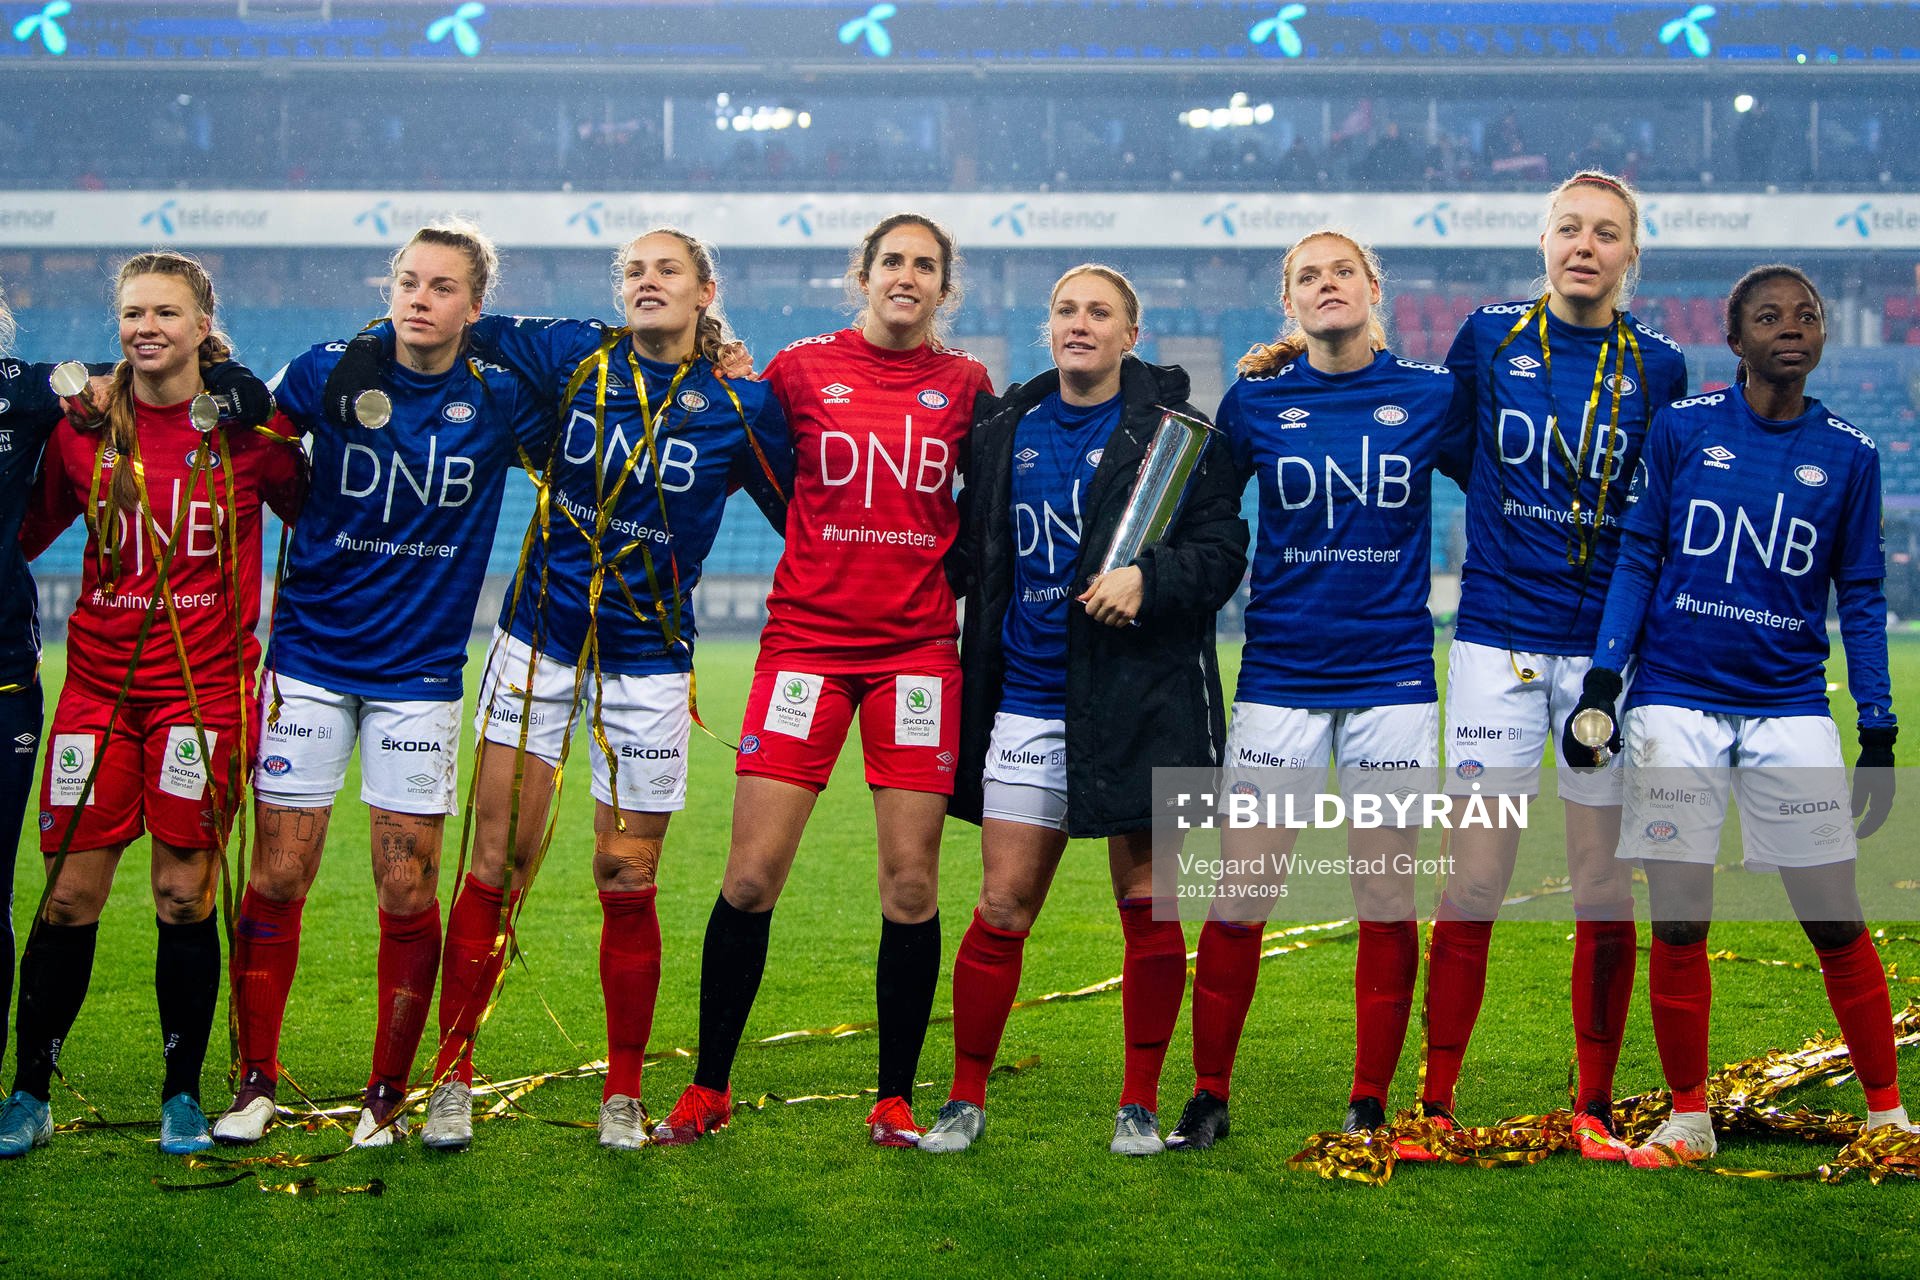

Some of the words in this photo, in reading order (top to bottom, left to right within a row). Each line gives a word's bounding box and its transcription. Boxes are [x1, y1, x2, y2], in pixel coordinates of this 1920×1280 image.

[178, 207, 267, 229] telenor
[1027, 209, 1116, 230] telenor
[1662, 208, 1752, 230] telenor
[1396, 359, 1450, 375] coop
[1509, 369, 1536, 379] umbro
[1671, 393, 1726, 409] coop
[1827, 418, 1876, 449] coop
[564, 409, 698, 496] DNB
[1498, 400, 1628, 489] DNB
[820, 415, 949, 508] DNB
[1703, 459, 1730, 470] umbro
[340, 435, 475, 523] DNB
[1277, 436, 1411, 529] DNB
[334, 531, 458, 558] #huninvesterer
[1682, 492, 1818, 584] DNB
[1283, 545, 1401, 564] #huninvesterer
[1675, 592, 1805, 632] #huninvesterer
[530, 712, 544, 725] Bil
[318, 726, 332, 739] Bil
[1508, 727, 1523, 740] Bil
[381, 738, 441, 752] ŠKODA
[621, 745, 680, 760] ŠKODA
[1051, 753, 1066, 766] Bil
[1290, 757, 1306, 770] Bil
[1359, 759, 1421, 771] ŠKODA
[407, 786, 433, 795] umbro
[1778, 800, 1840, 816] ŠKODA
[1814, 837, 1841, 846] umbro
